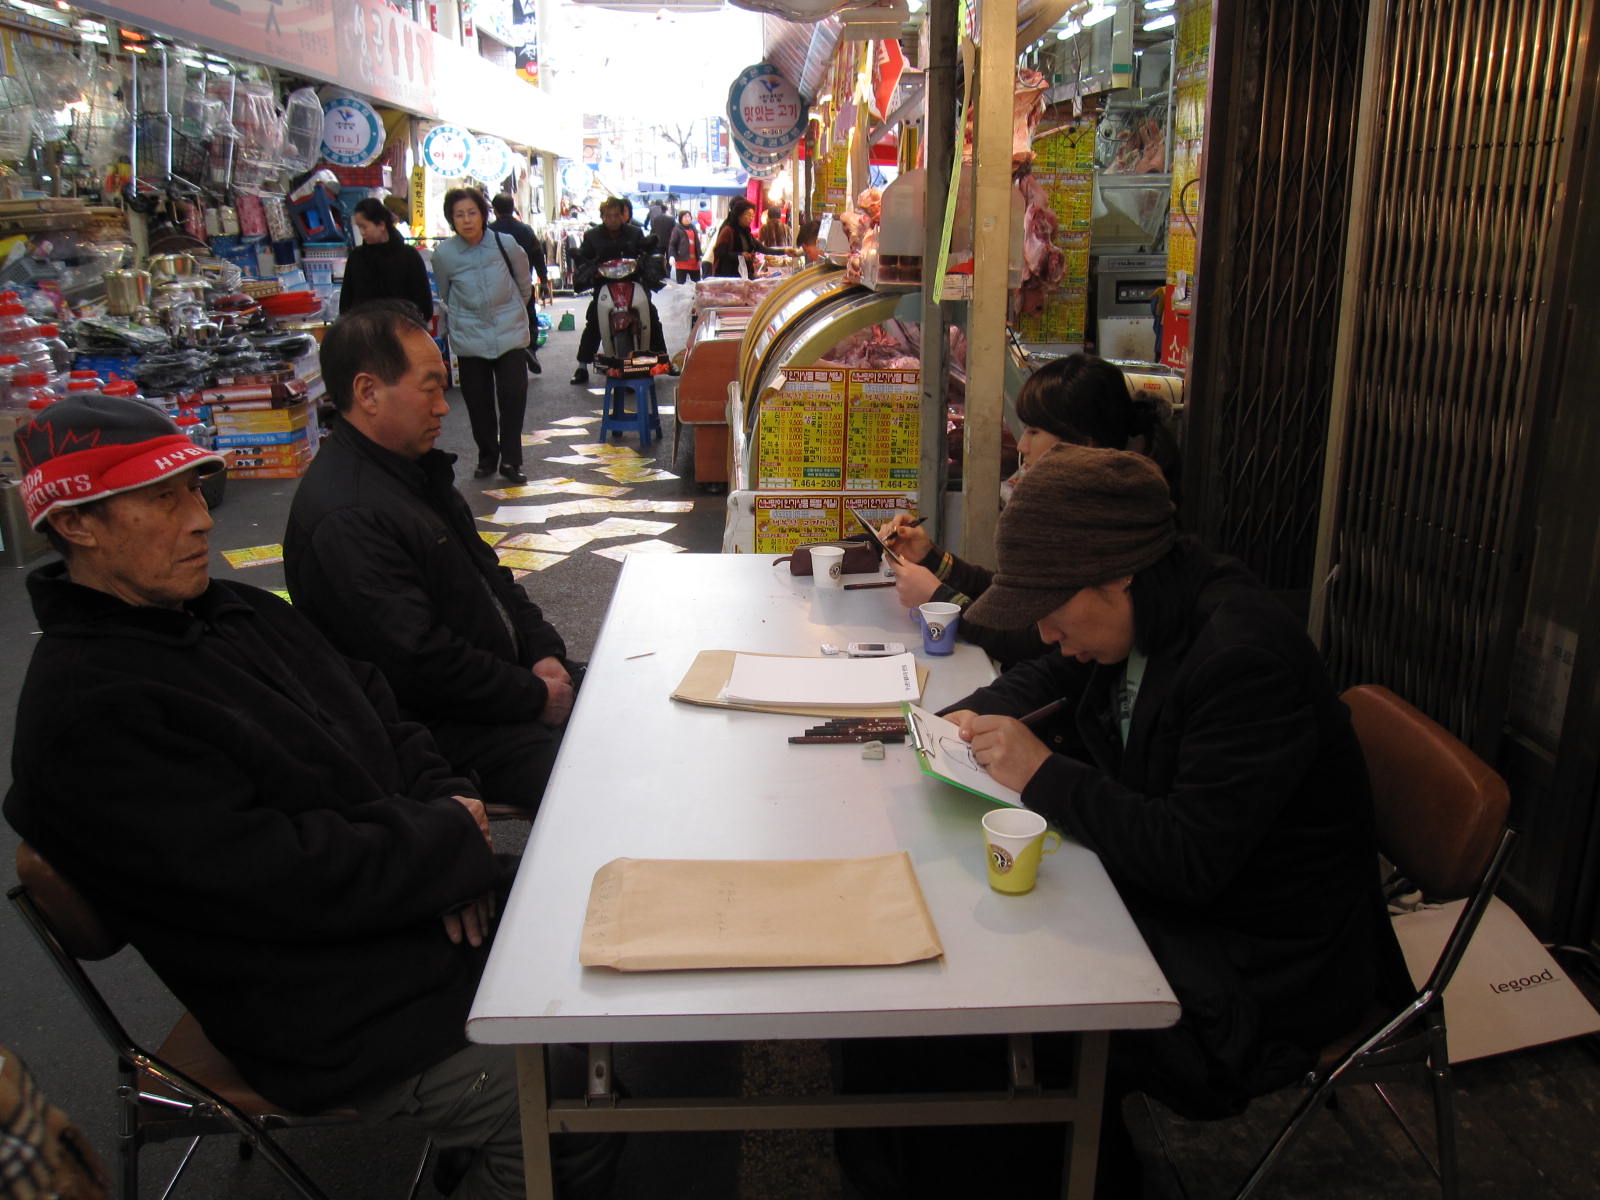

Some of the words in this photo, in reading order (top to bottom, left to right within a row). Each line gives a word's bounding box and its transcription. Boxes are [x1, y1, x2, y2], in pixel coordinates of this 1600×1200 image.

[744, 105, 775, 122] 맛있는
[778, 104, 797, 119] 고기
[793, 479, 841, 488] T.464-2303
[879, 480, 918, 489] T.464-23
[1489, 968, 1553, 994] legood
